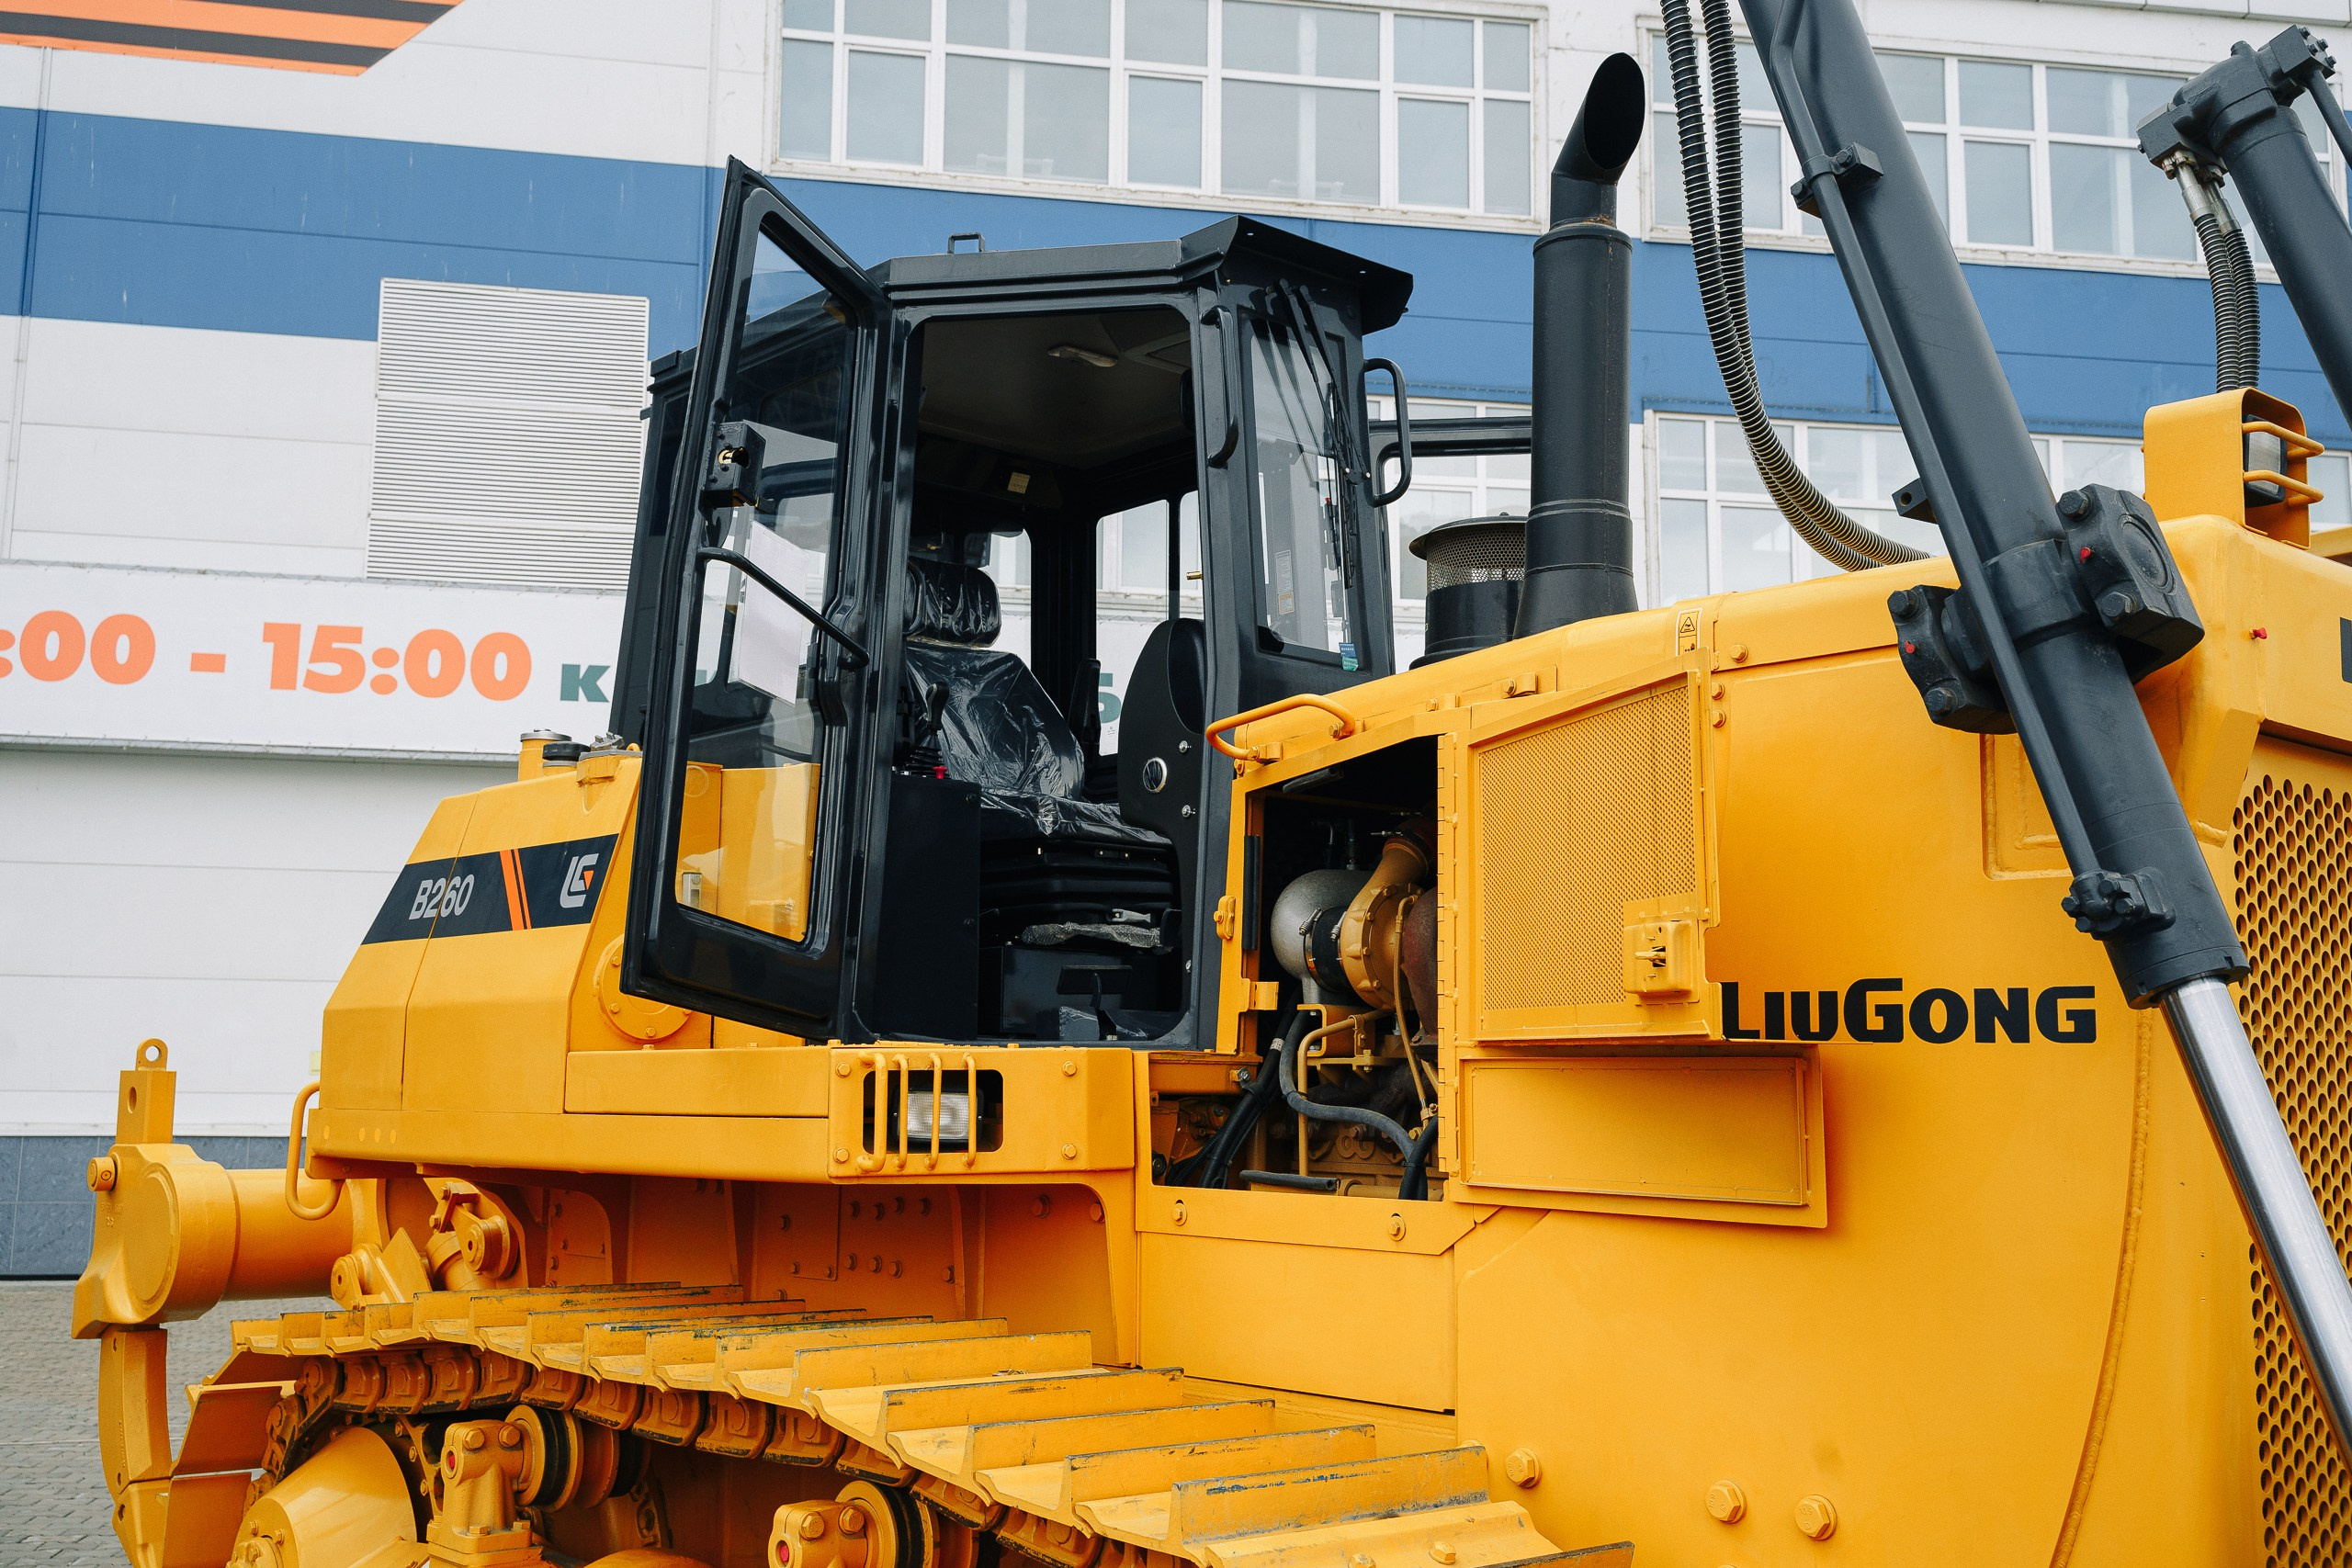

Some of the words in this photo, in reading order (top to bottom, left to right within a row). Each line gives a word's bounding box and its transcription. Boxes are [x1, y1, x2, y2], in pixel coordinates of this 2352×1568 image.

[190, 653, 226, 672] -
[262, 622, 532, 702] 15:00
[408, 874, 475, 920] B260
